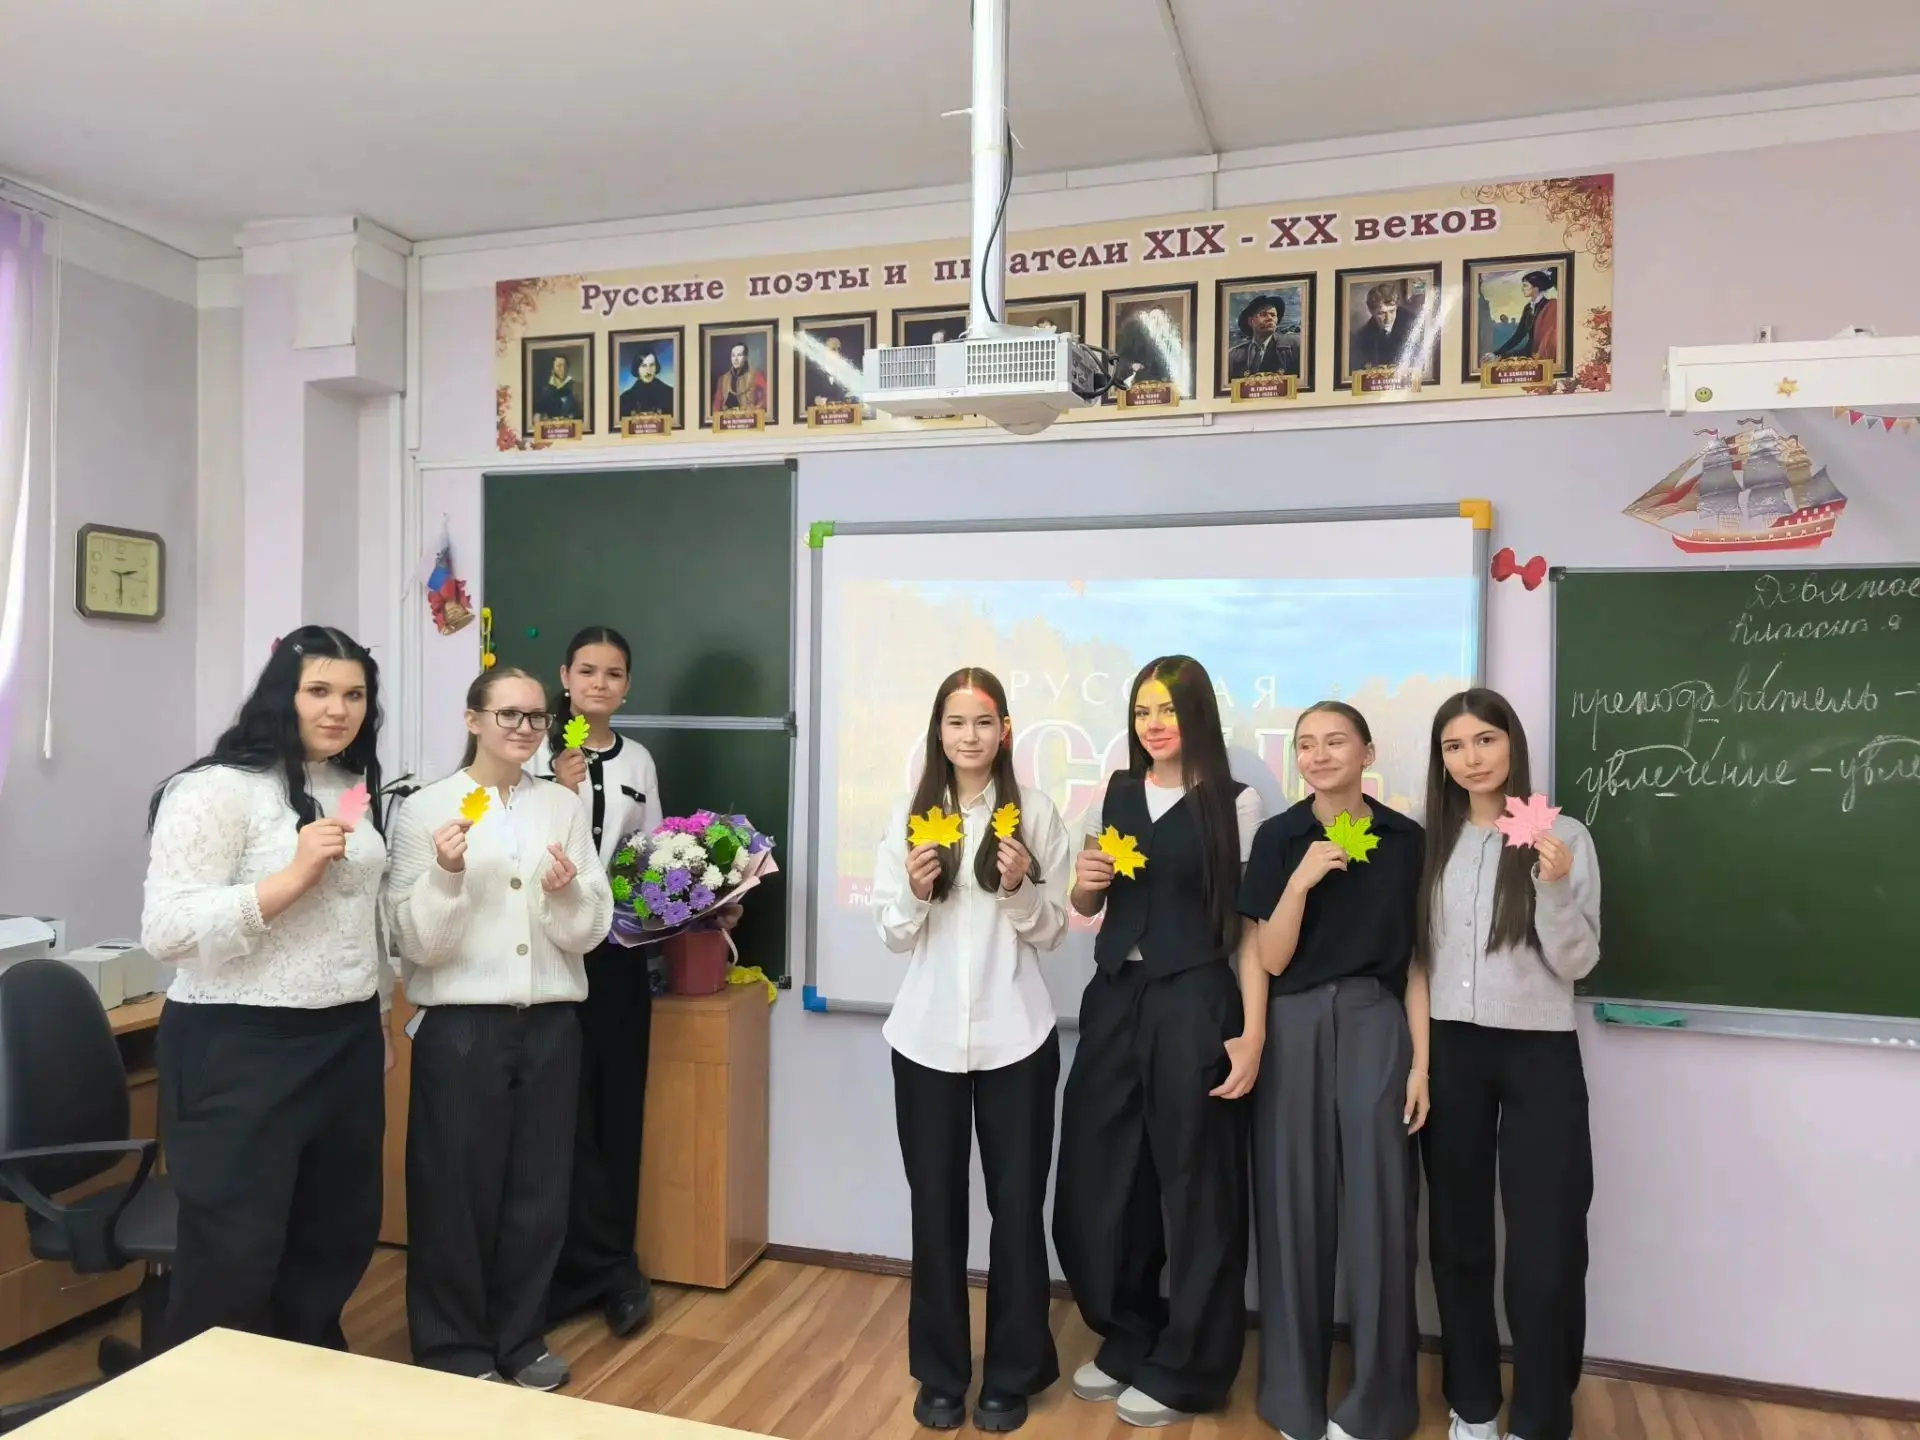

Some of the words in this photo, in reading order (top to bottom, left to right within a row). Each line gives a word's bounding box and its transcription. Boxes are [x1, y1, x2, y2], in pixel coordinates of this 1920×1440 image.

[581, 279, 725, 316] Русские
[749, 267, 870, 297] поэты
[884, 264, 907, 285] и
[934, 242, 1129, 281] патели
[1143, 224, 1226, 261] XIX
[1269, 213, 1338, 249] XX
[1354, 207, 1498, 241] веков
